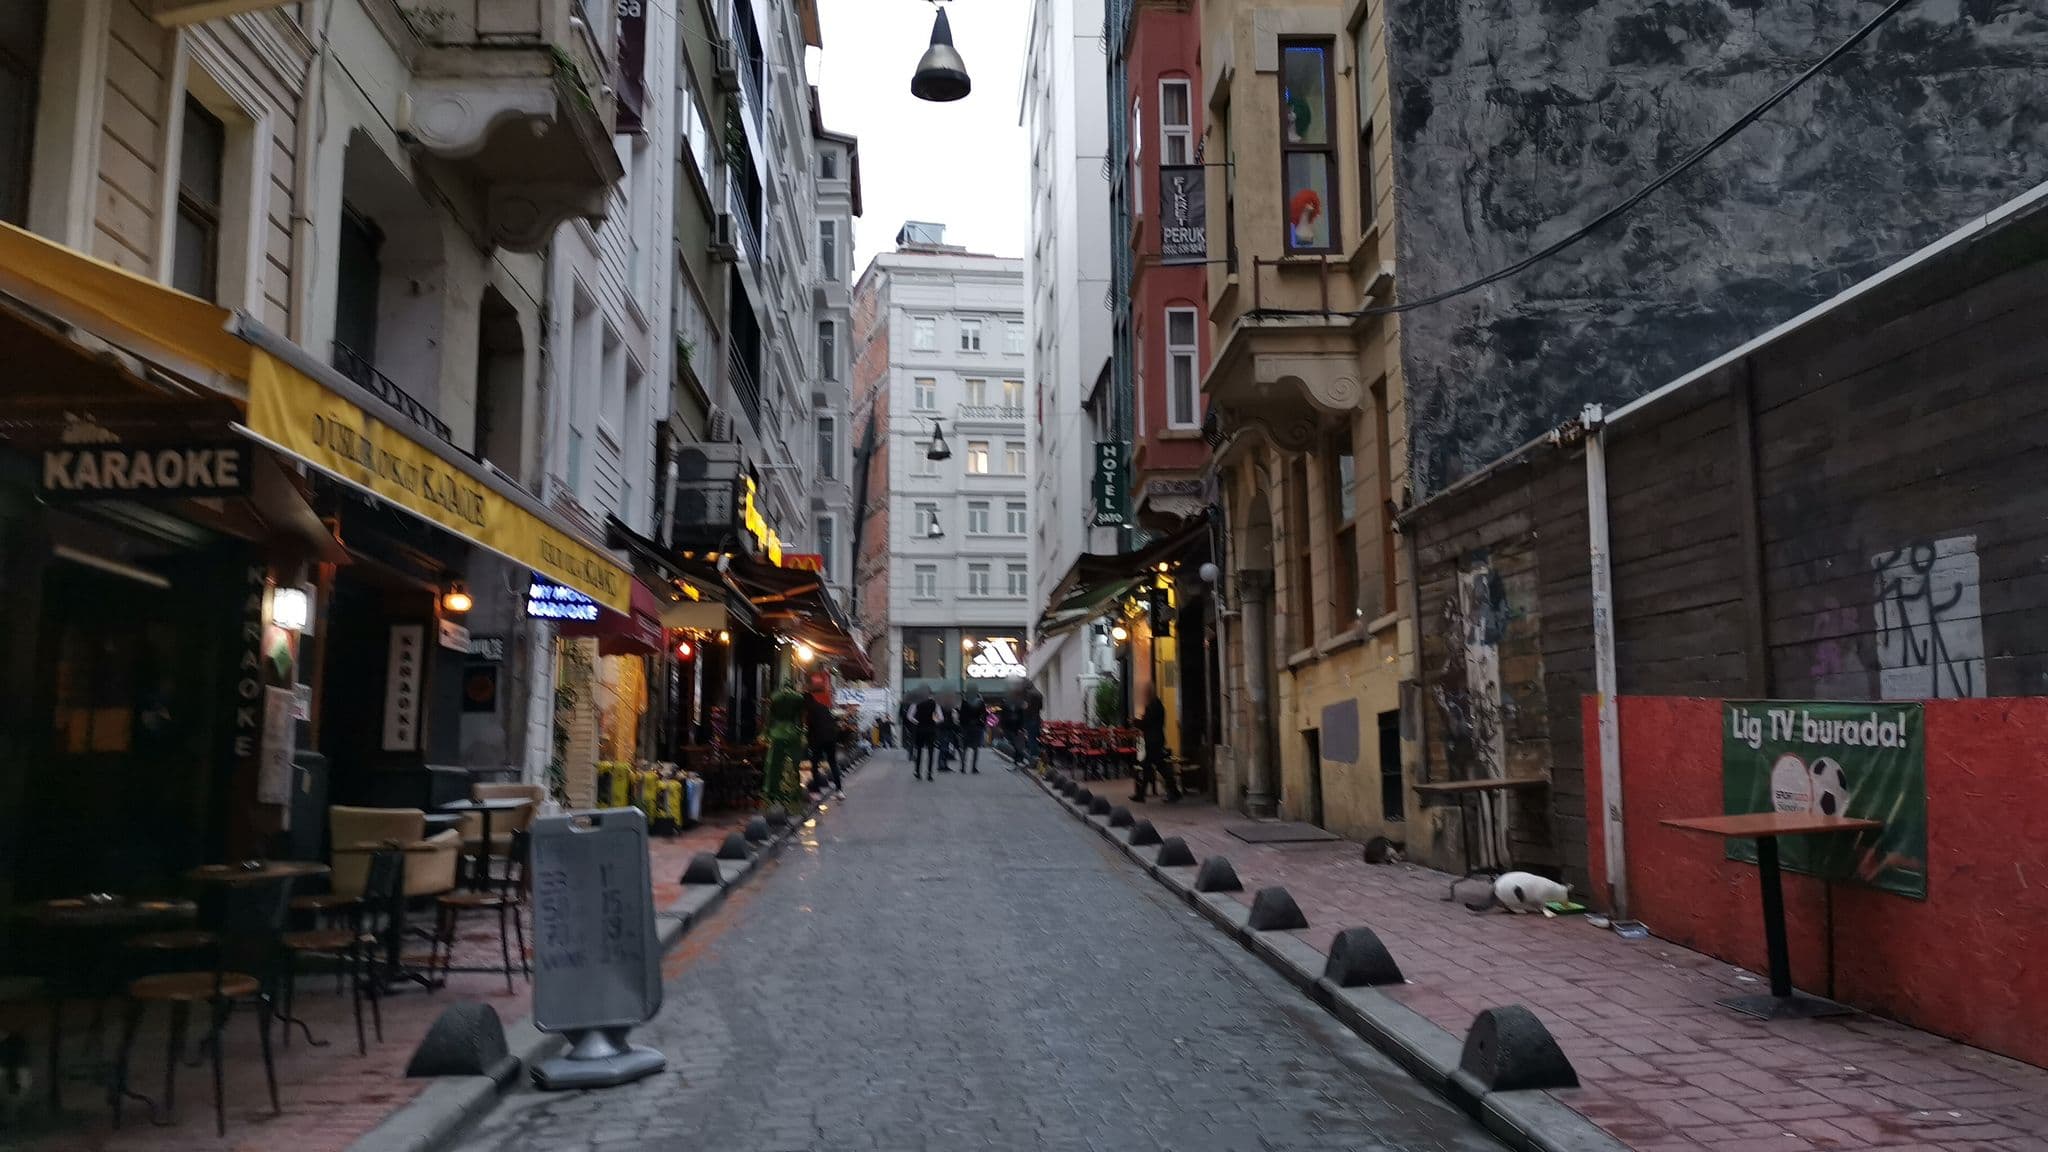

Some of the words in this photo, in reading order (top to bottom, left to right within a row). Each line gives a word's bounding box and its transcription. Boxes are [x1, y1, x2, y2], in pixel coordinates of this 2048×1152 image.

[44, 449, 241, 490] KARAOKE
[1102, 445, 1118, 510] HOTEL
[236, 566, 265, 757] KARAOKE
[1732, 708, 1762, 749] Lig
[1768, 709, 1795, 741] TV
[1802, 710, 1907, 748] burada!
